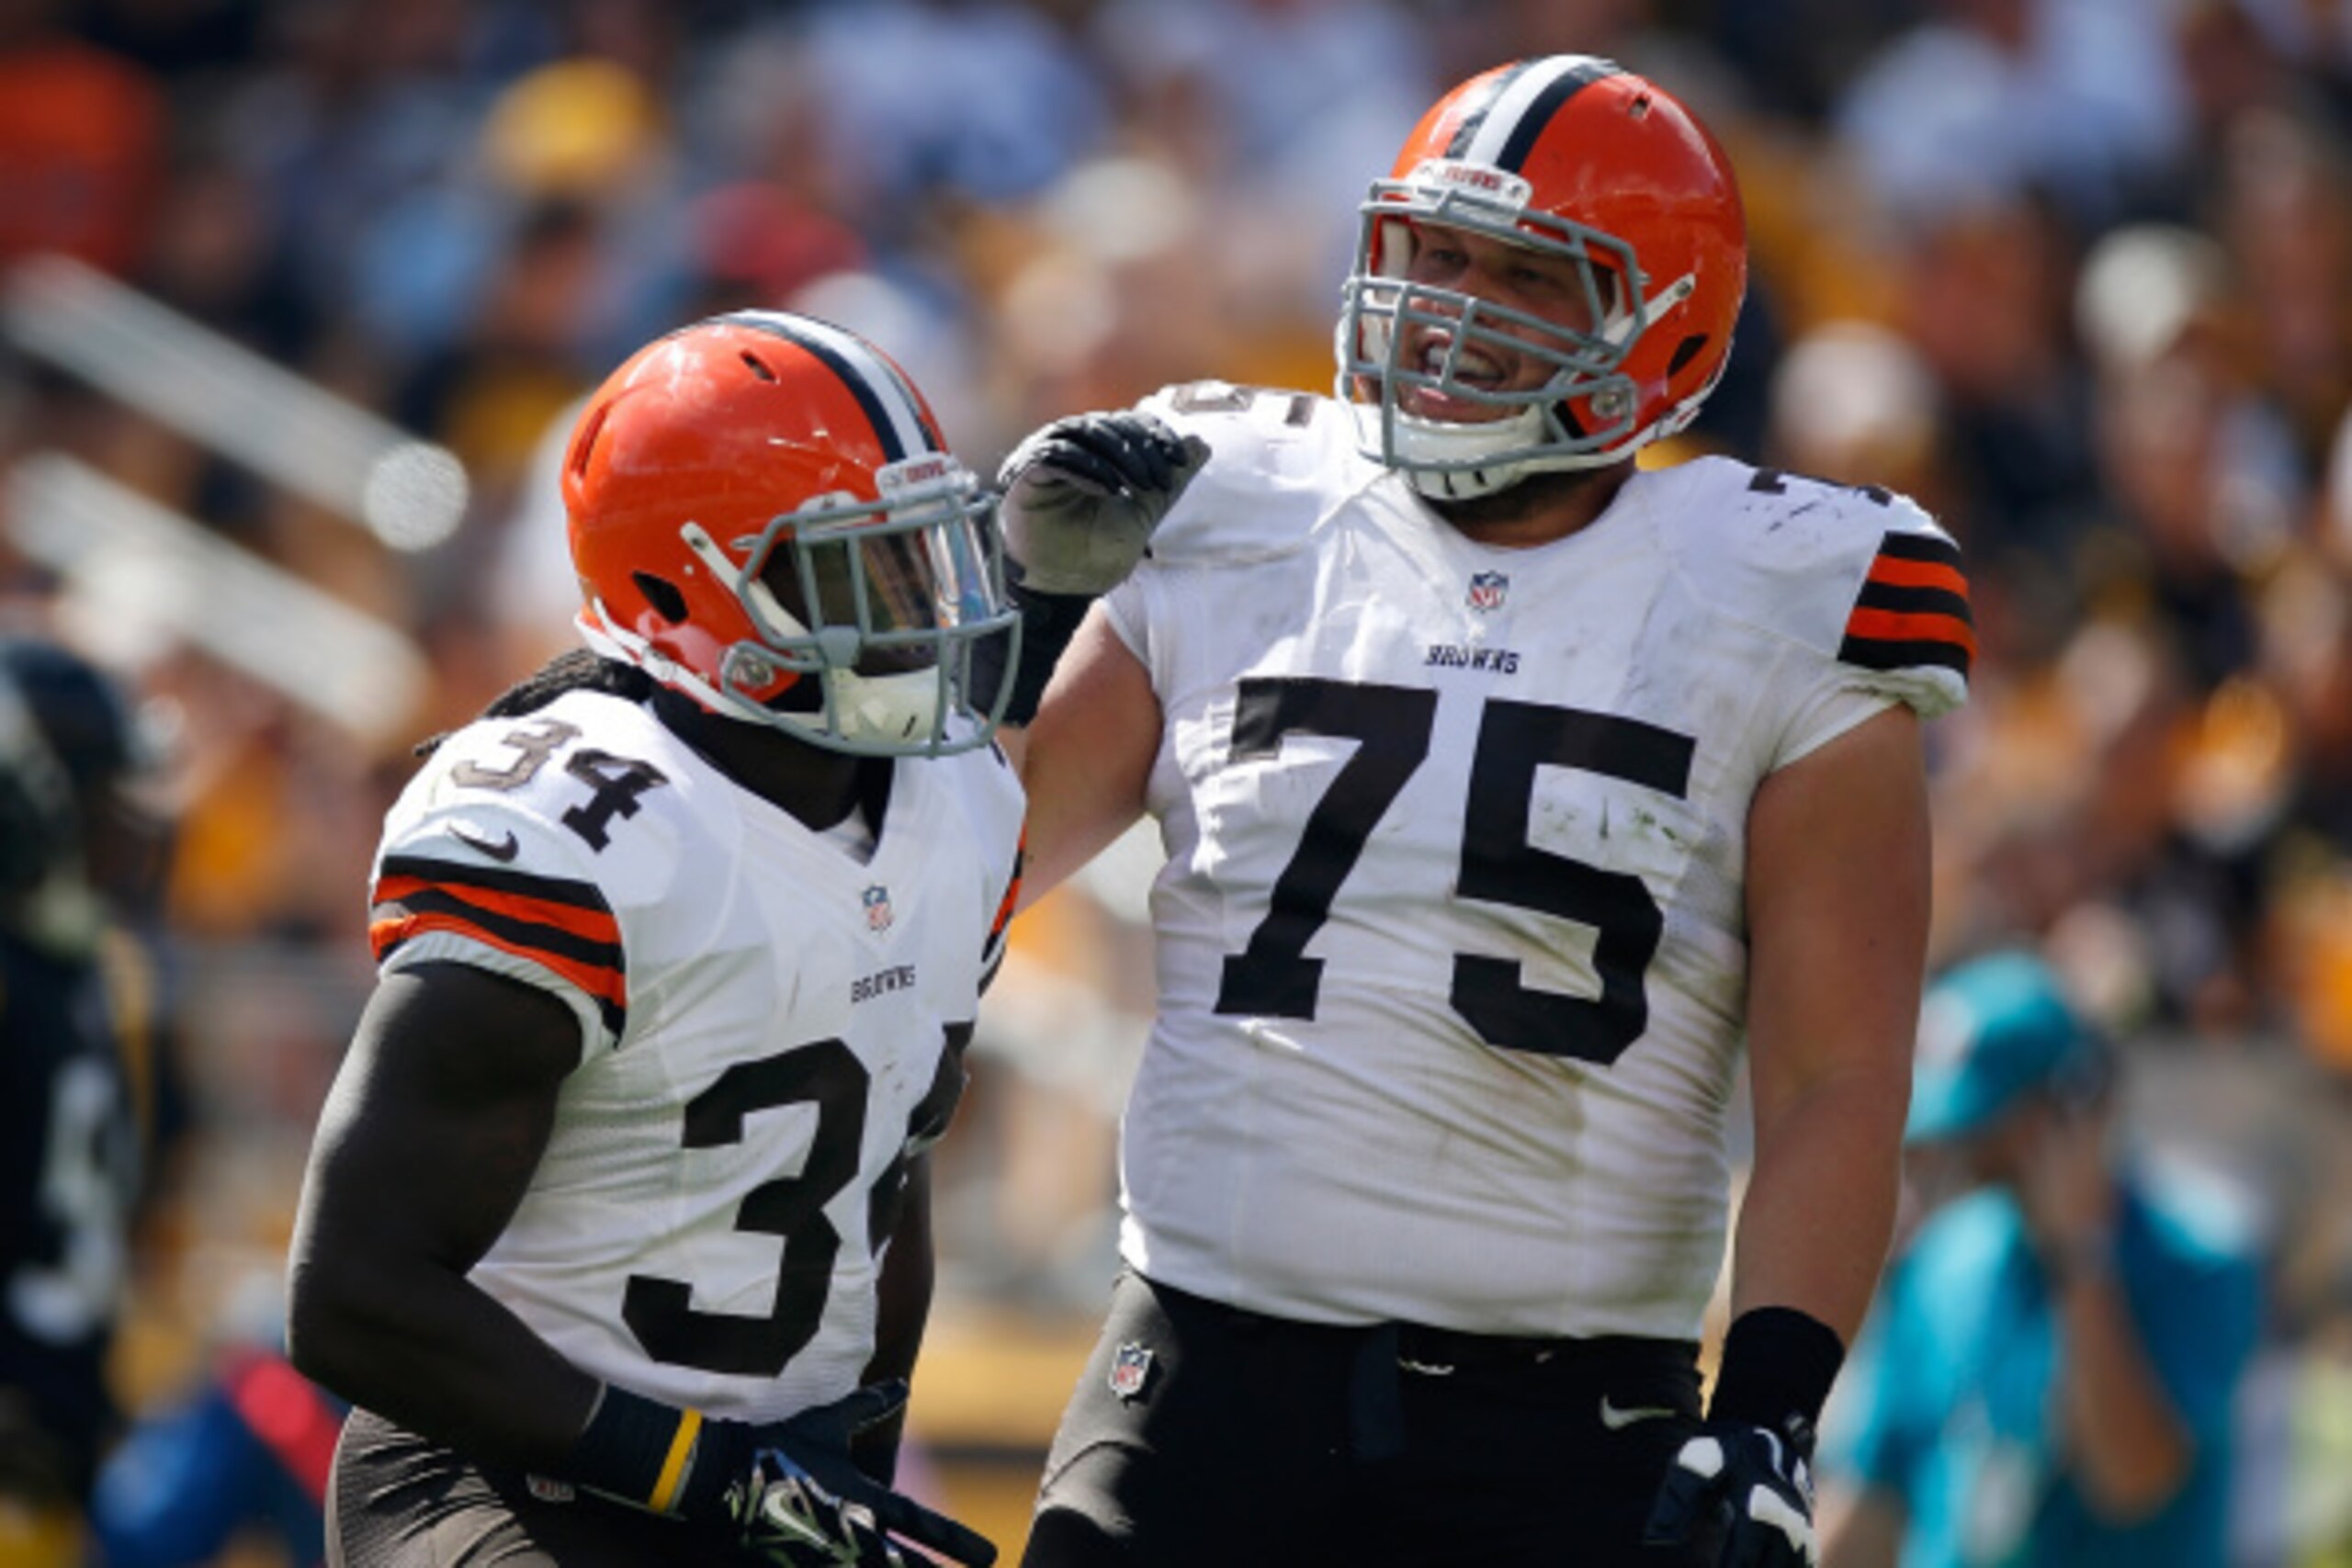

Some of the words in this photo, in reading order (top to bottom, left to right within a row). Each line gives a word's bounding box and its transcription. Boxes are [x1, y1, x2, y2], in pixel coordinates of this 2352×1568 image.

[1424, 645, 1521, 674] BROWNS
[450, 718, 671, 854] 34
[1214, 677, 1696, 1066] 75
[851, 964, 916, 1004] BROWNS
